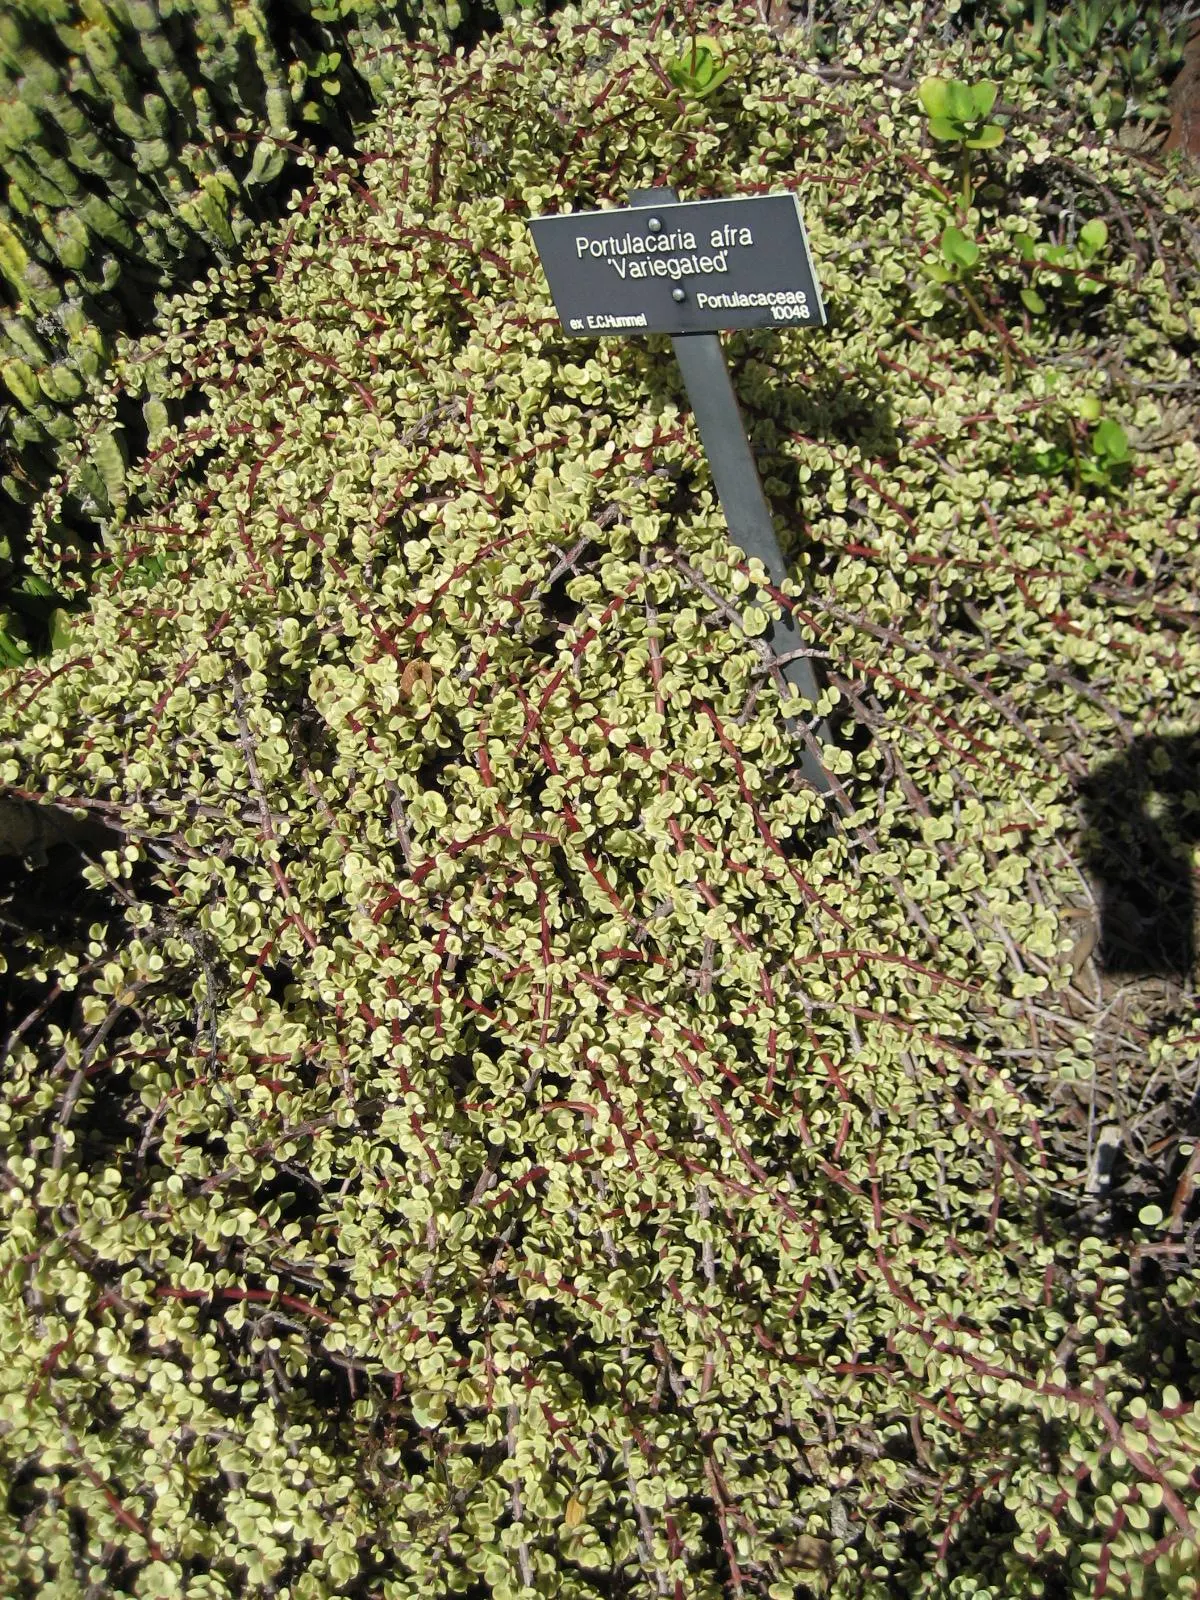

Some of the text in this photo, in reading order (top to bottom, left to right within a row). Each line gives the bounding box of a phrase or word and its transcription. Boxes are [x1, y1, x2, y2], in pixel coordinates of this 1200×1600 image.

[576, 224, 753, 258] Portulacaria afra
[608, 250, 728, 280] 'Variegated'
[697, 291, 806, 309] Portulacaceae
[771, 305, 810, 320] 10048
[570, 318, 584, 330] ex
